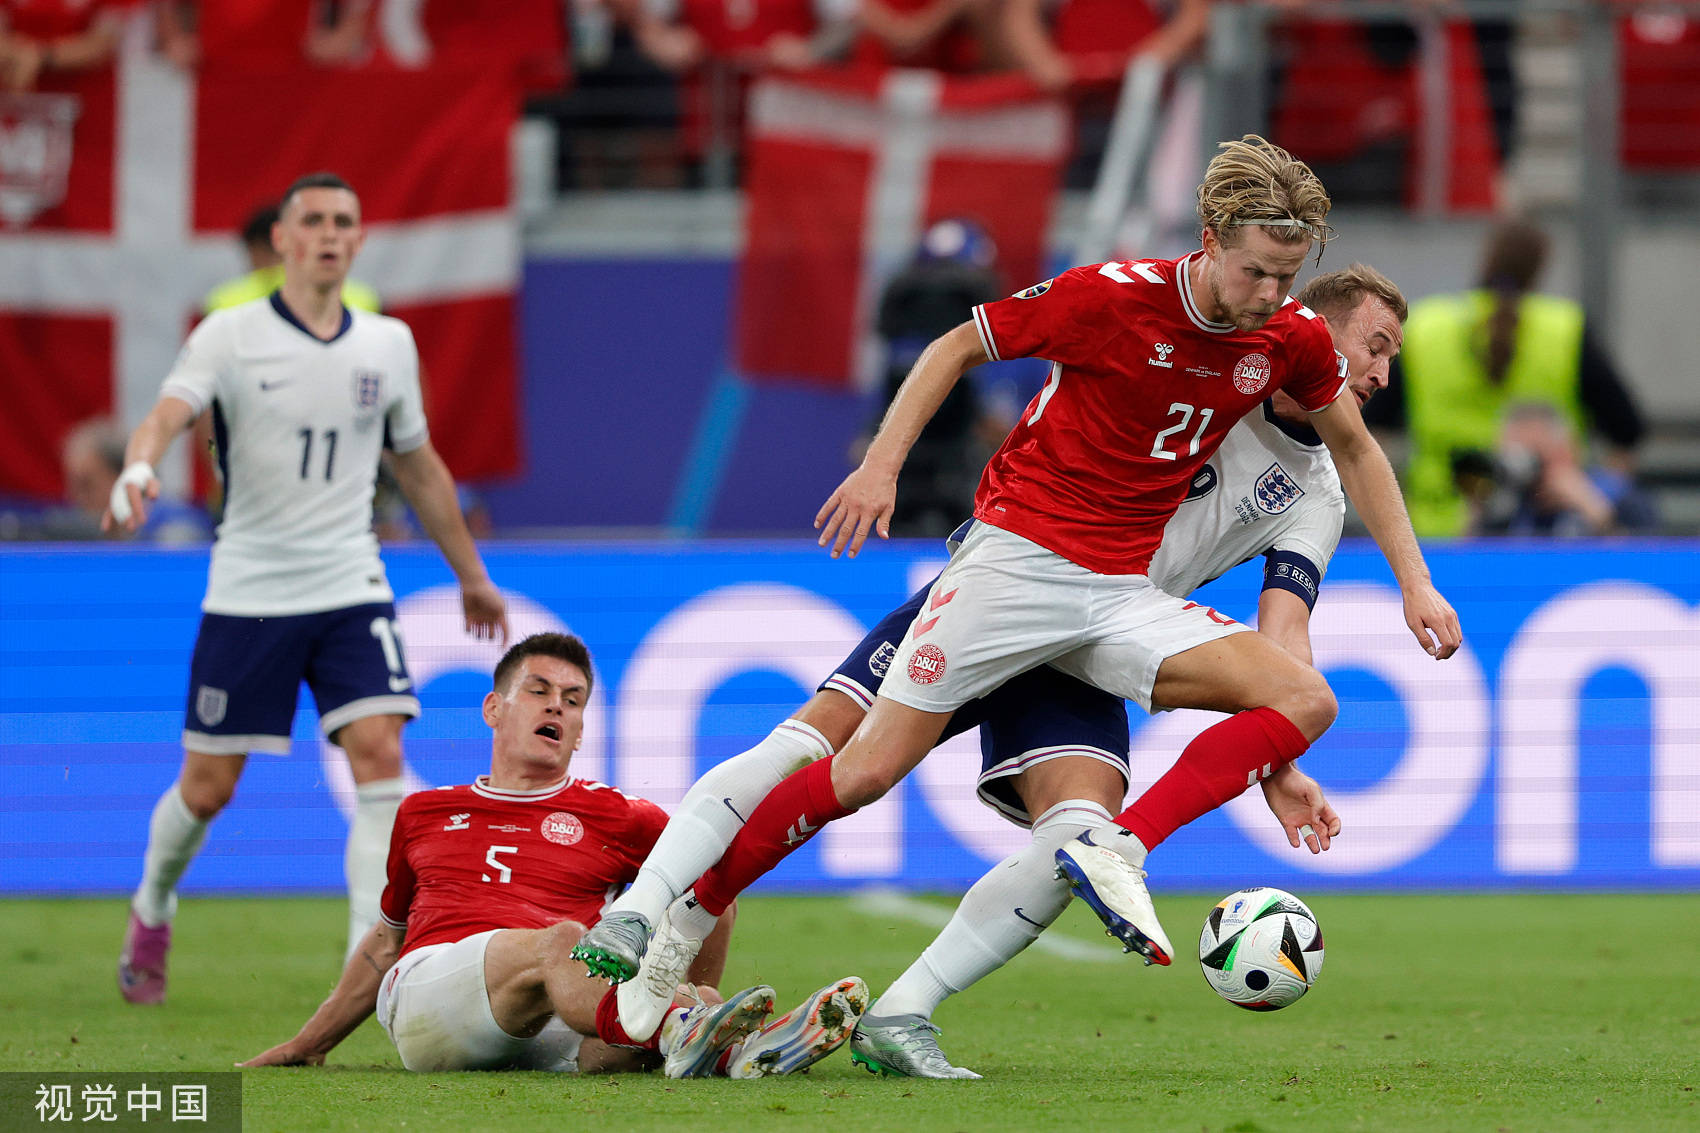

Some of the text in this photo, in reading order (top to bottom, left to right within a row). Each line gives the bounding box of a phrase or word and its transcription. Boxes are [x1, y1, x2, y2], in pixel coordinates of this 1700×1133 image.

[1148, 357, 1174, 369] hummel
[1241, 366, 1263, 380] DBU
[1150, 402, 1214, 461] 21
[299, 427, 338, 481] 11
[914, 655, 939, 673] DBU
[550, 822, 576, 835] DBU
[481, 845, 518, 883] 5
